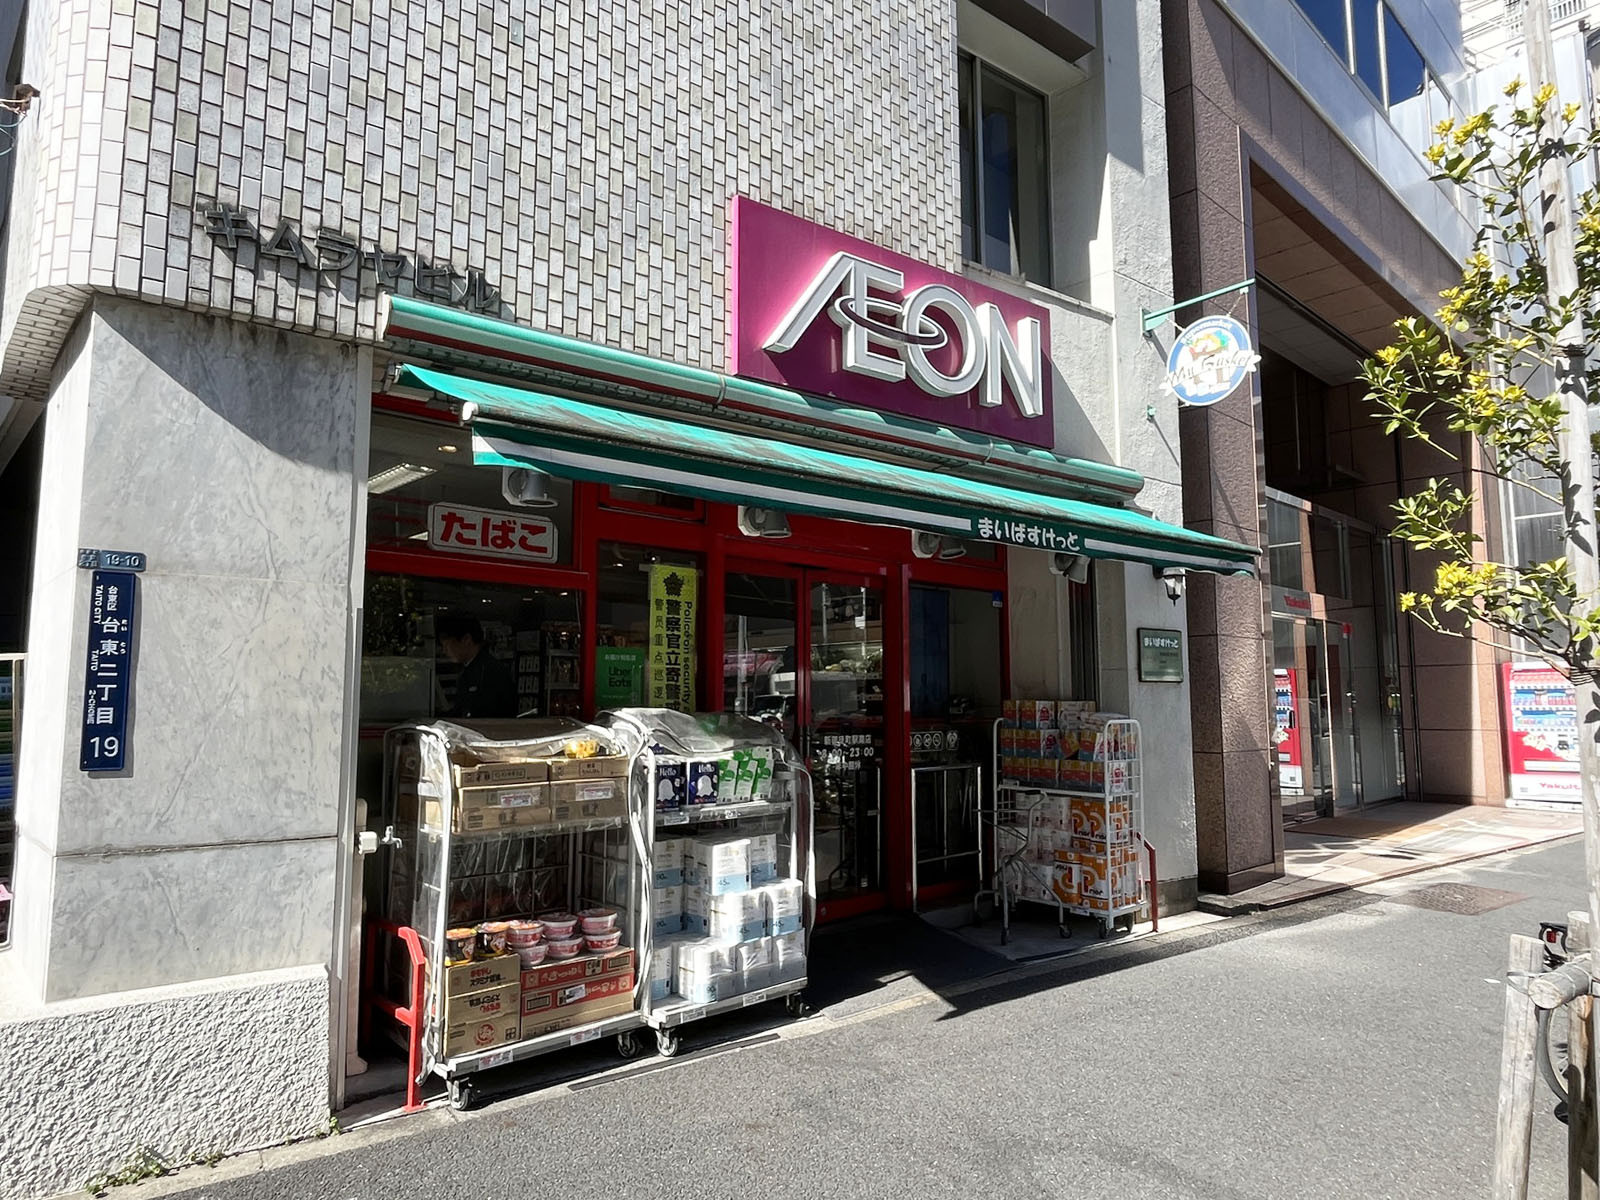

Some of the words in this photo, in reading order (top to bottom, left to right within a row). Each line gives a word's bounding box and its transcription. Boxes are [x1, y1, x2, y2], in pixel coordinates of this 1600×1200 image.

[440, 510, 549, 554] たばこ
[977, 516, 1081, 551] まいばすけっと
[95, 584, 104, 606] TAITO
[106, 585, 119, 611] 台東区
[93, 607, 102, 625] CITY
[683, 601, 693, 638] Police
[91, 649, 100, 671] TAITO
[96, 616, 121, 725] 台東二丁目
[608, 665, 632, 676] Uber
[608, 676, 632, 688] Eats
[86, 689, 97, 725] 2-CHOME
[90, 736, 119, 758] 19
[660, 766, 677, 777] Hello
[698, 763, 716, 774] Hello
